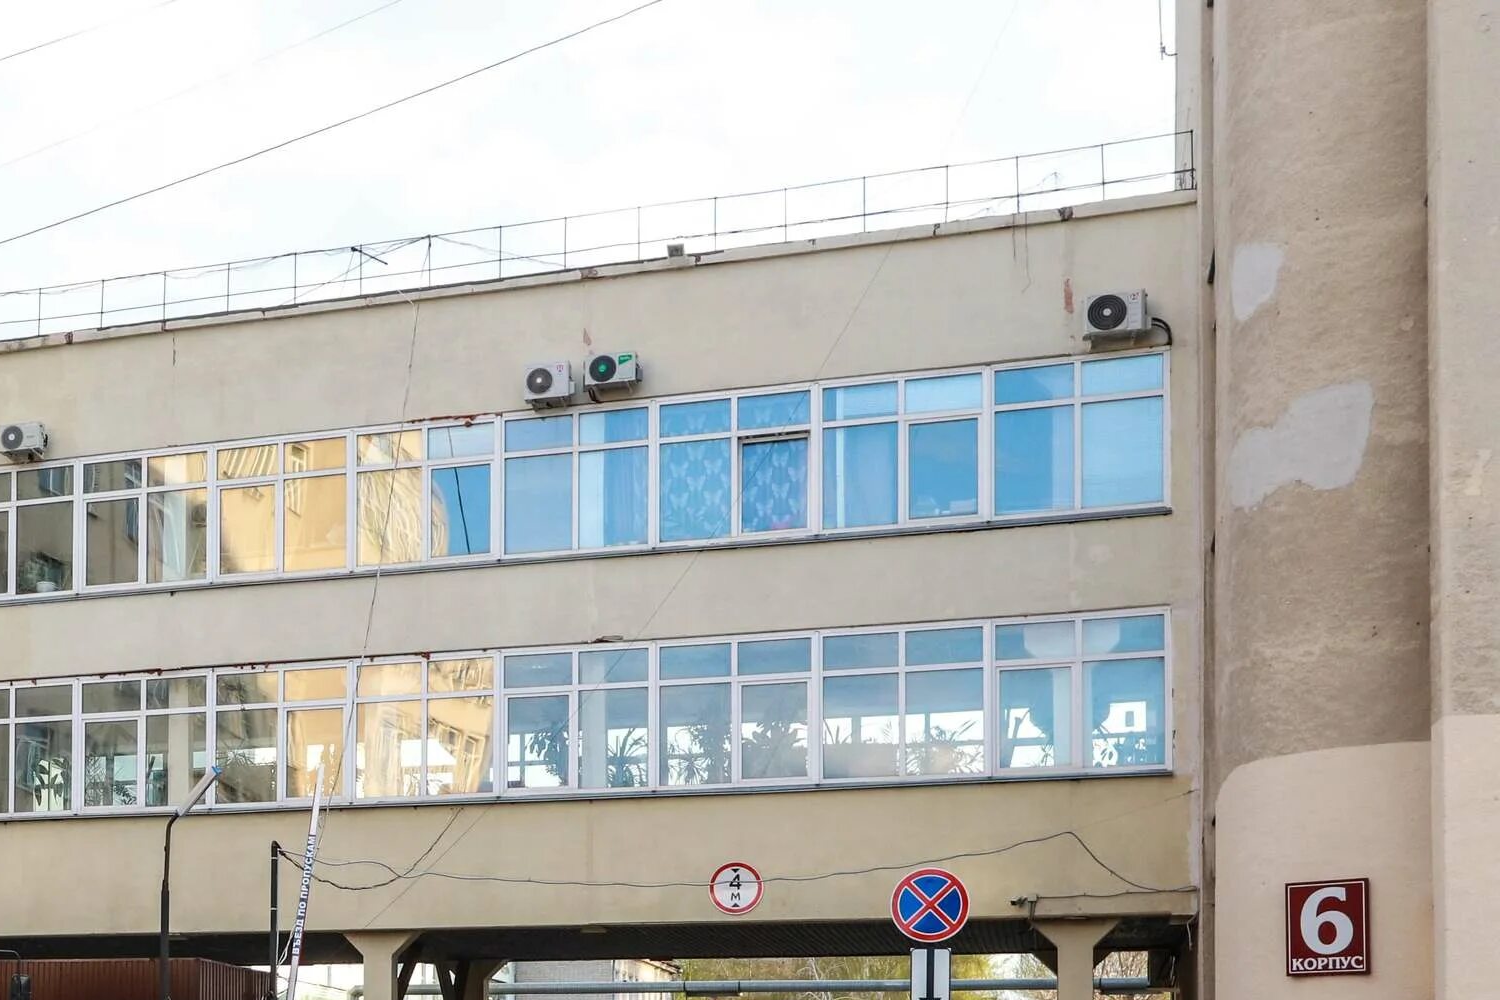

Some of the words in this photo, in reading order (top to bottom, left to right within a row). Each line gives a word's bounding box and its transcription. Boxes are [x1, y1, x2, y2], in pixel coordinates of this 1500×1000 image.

[300, 836, 317, 899] ПРОПУСКАМ
[729, 873, 742, 890] 4
[297, 901, 307, 916] ПО
[1300, 886, 1354, 955] 6
[291, 919, 305, 955] ВЪЕЗД
[1291, 955, 1364, 971] КОРПУС
